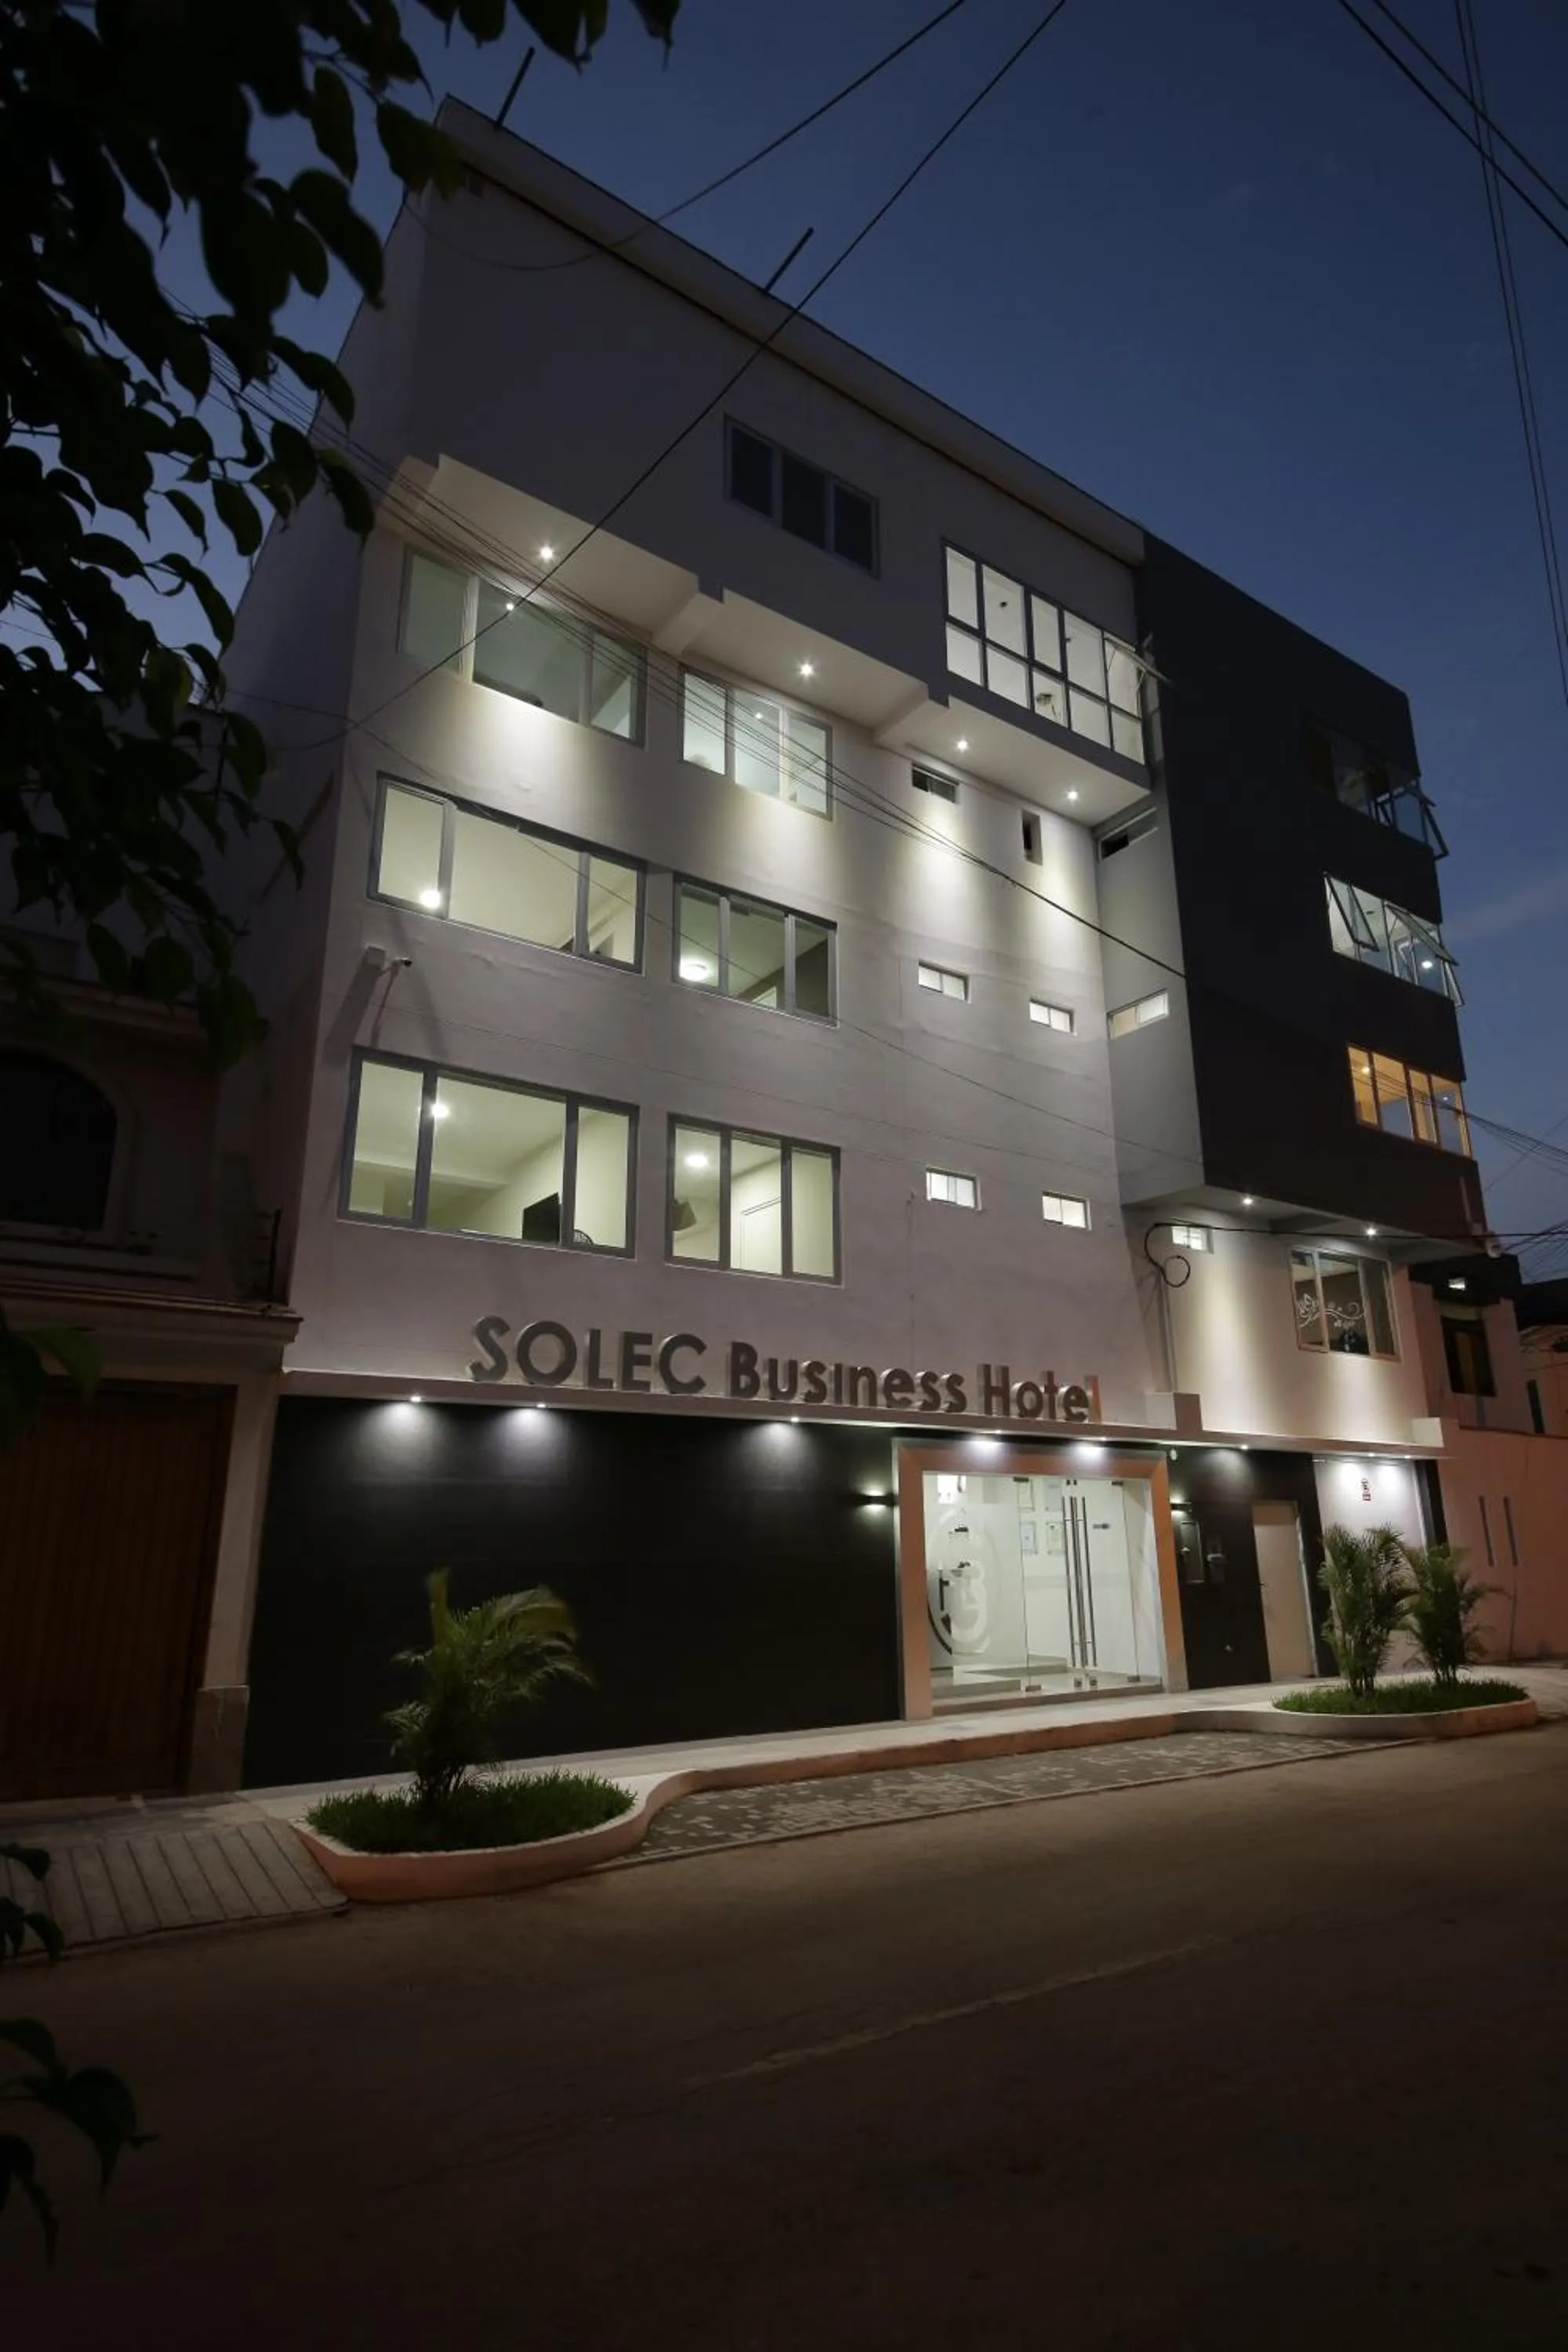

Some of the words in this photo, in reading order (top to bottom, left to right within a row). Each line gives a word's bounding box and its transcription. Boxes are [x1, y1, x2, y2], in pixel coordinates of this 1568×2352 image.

[468, 1316, 706, 1395] SOLEC
[726, 1341, 968, 1414] Business
[978, 1363, 1102, 1424] Hotel
